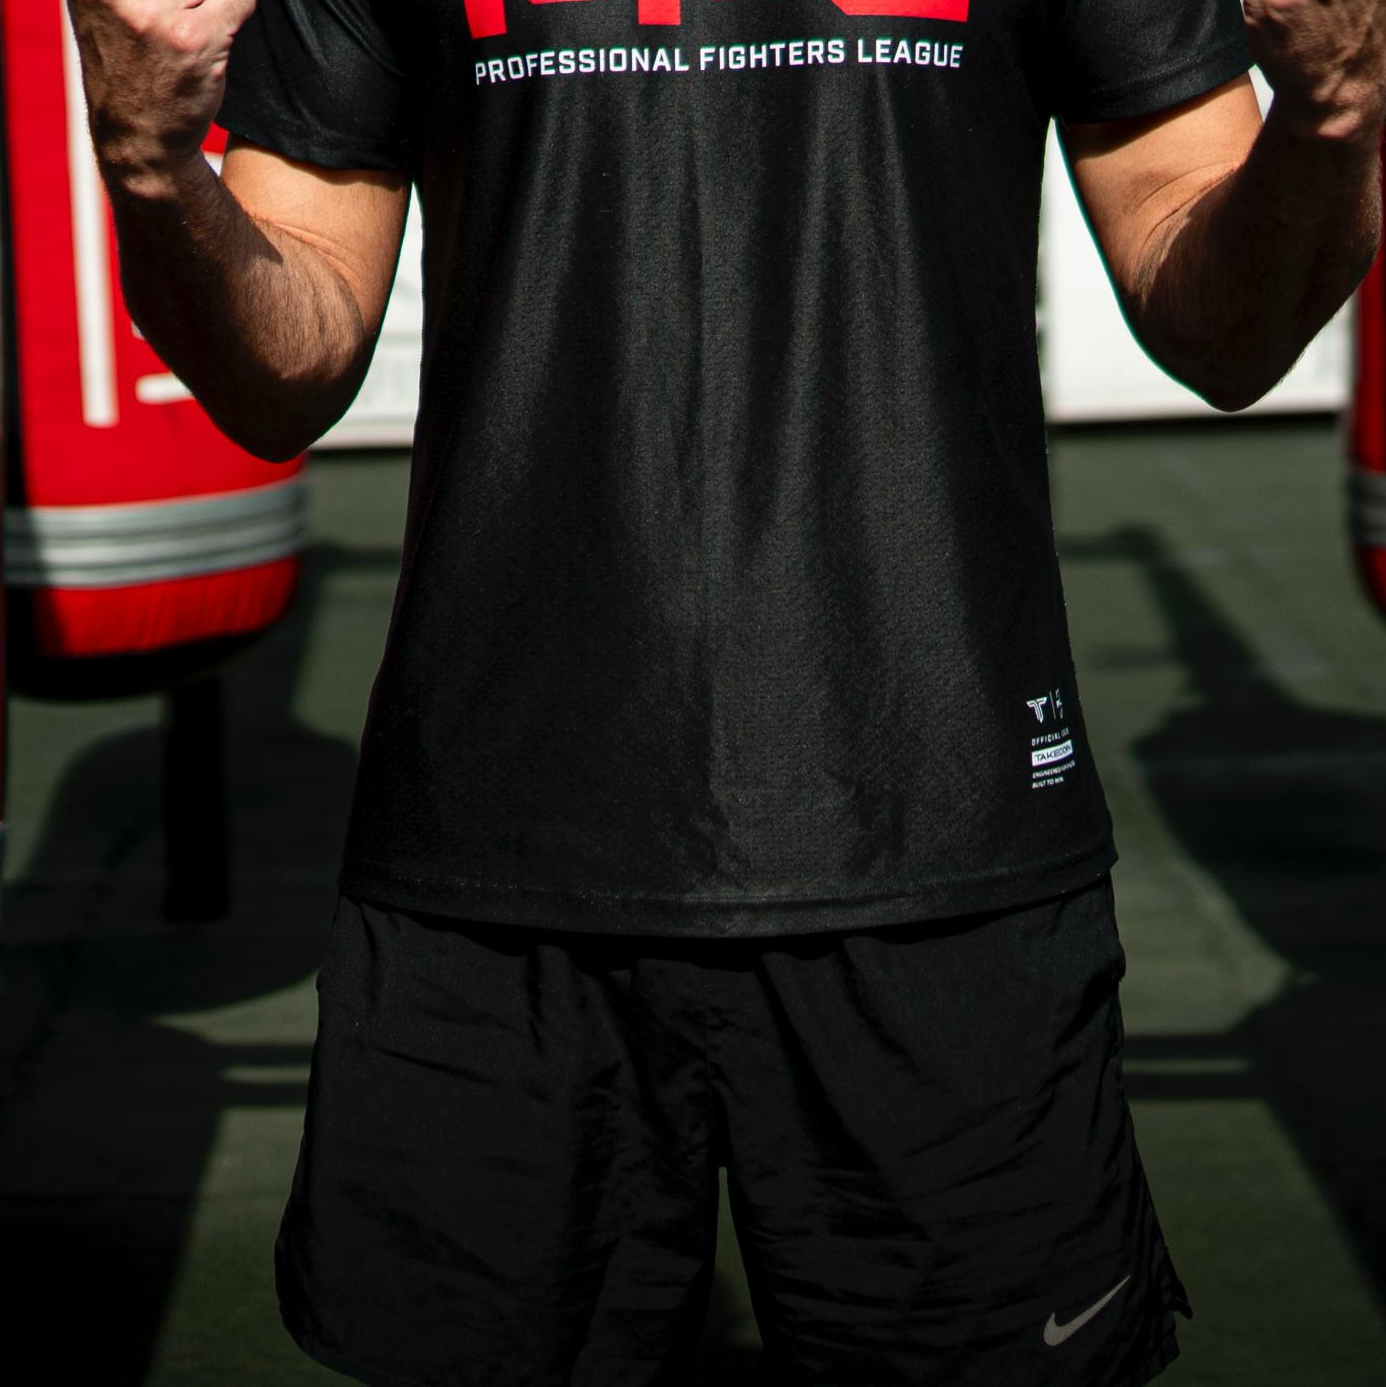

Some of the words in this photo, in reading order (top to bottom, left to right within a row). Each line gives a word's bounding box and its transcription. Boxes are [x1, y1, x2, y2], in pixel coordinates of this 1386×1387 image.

[475, 47, 689, 85] PROFESSIONAL
[699, 40, 845, 71] FIGHTERS
[857, 37, 963, 69] LEAGUE
